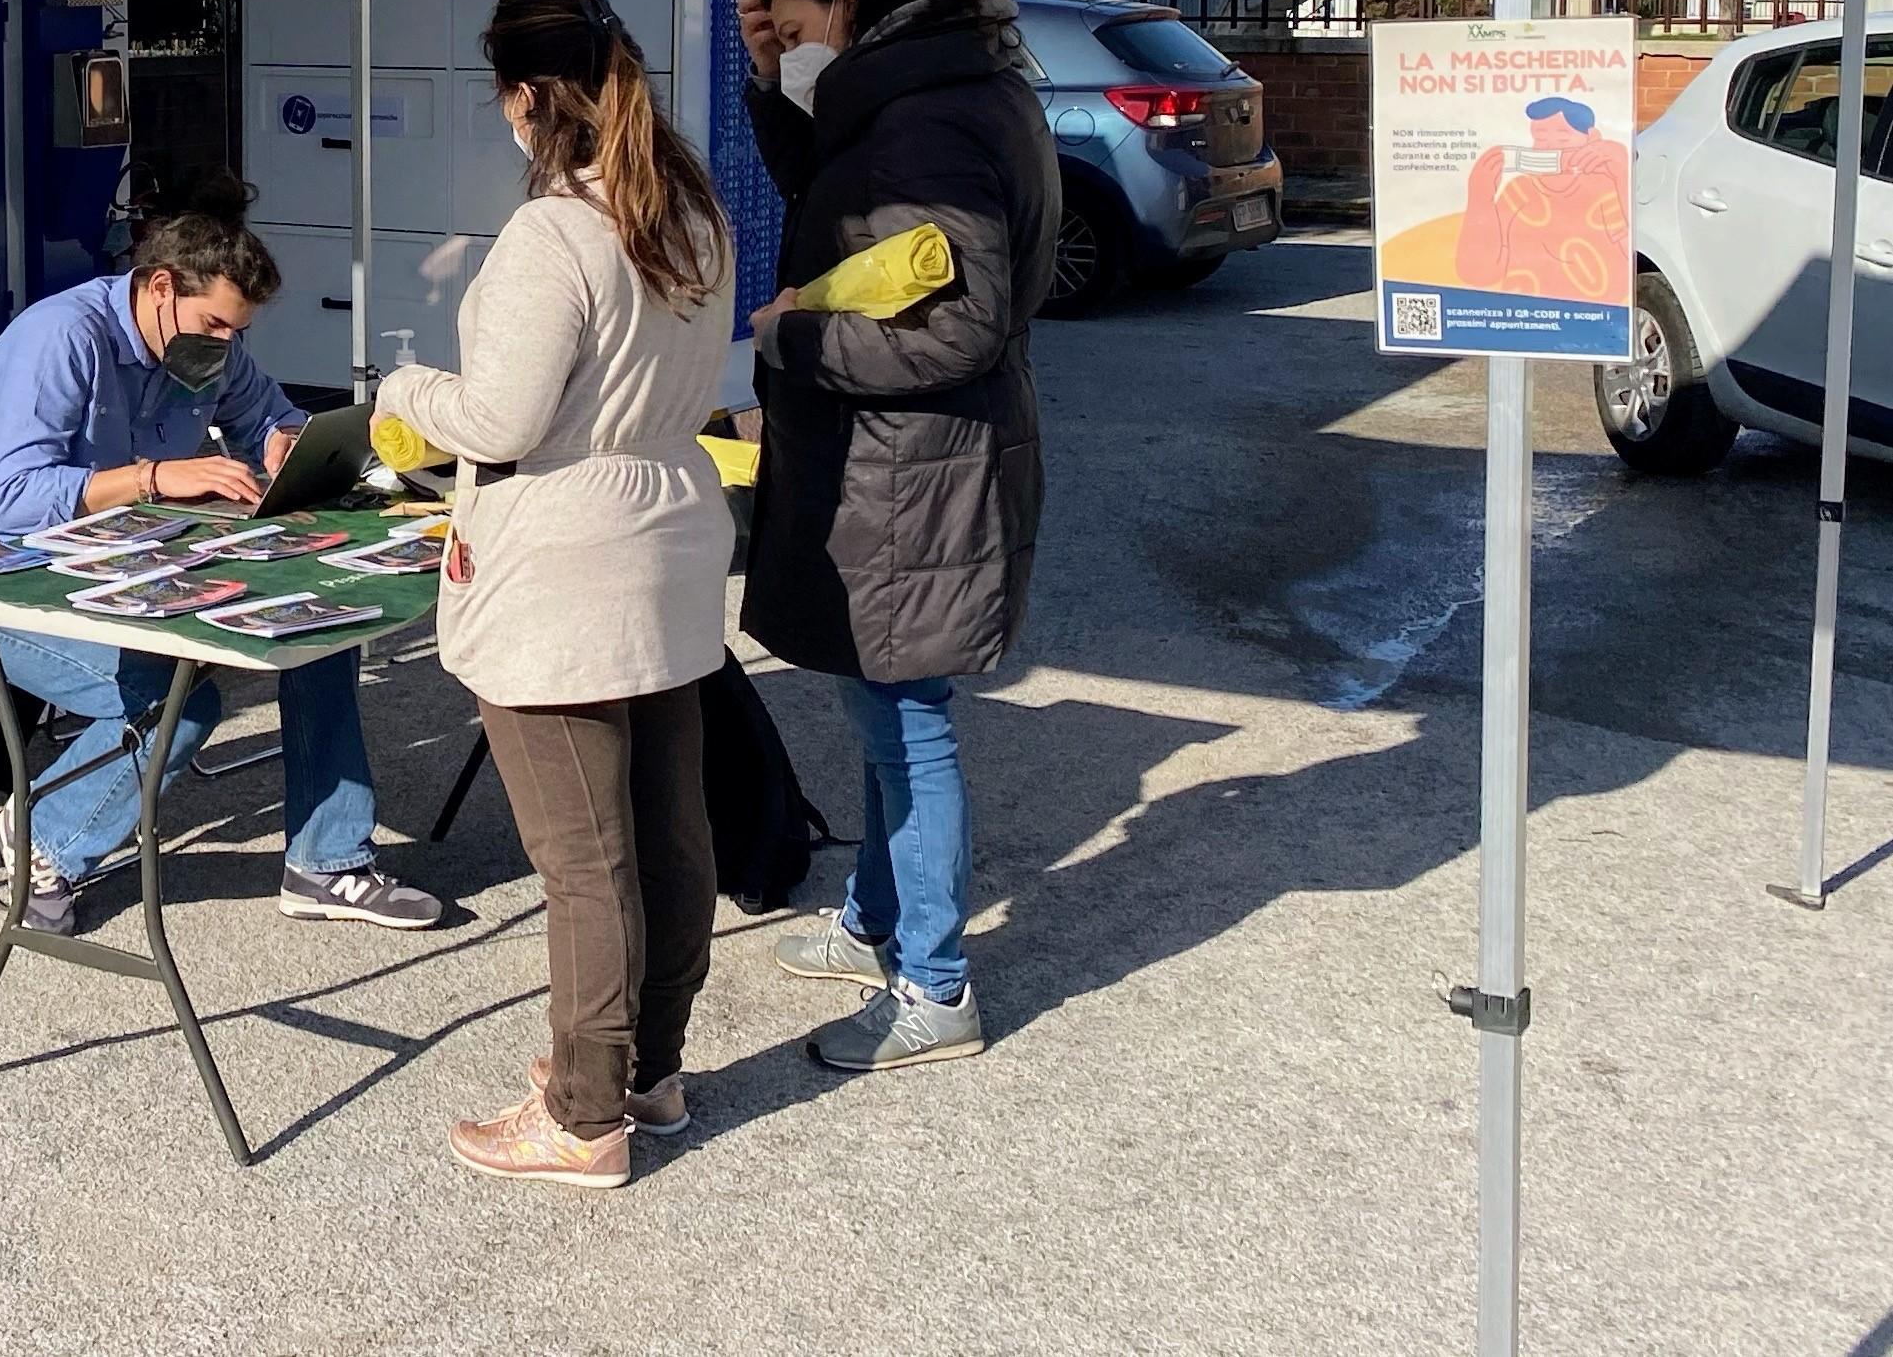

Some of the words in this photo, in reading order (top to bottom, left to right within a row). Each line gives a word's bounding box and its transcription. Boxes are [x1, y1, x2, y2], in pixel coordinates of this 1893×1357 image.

[1399, 52, 1434, 71] LA
[1450, 48, 1628, 70] MASCHERINA
[1399, 74, 1458, 94] NON
[1463, 74, 1485, 93] SI
[1492, 72, 1596, 94] BUTTA.
[1392, 129, 1414, 137] NON
[1392, 140, 1448, 149] mascherina
[1514, 309, 1561, 319] QR-CODE
[330, 874, 371, 905] N
